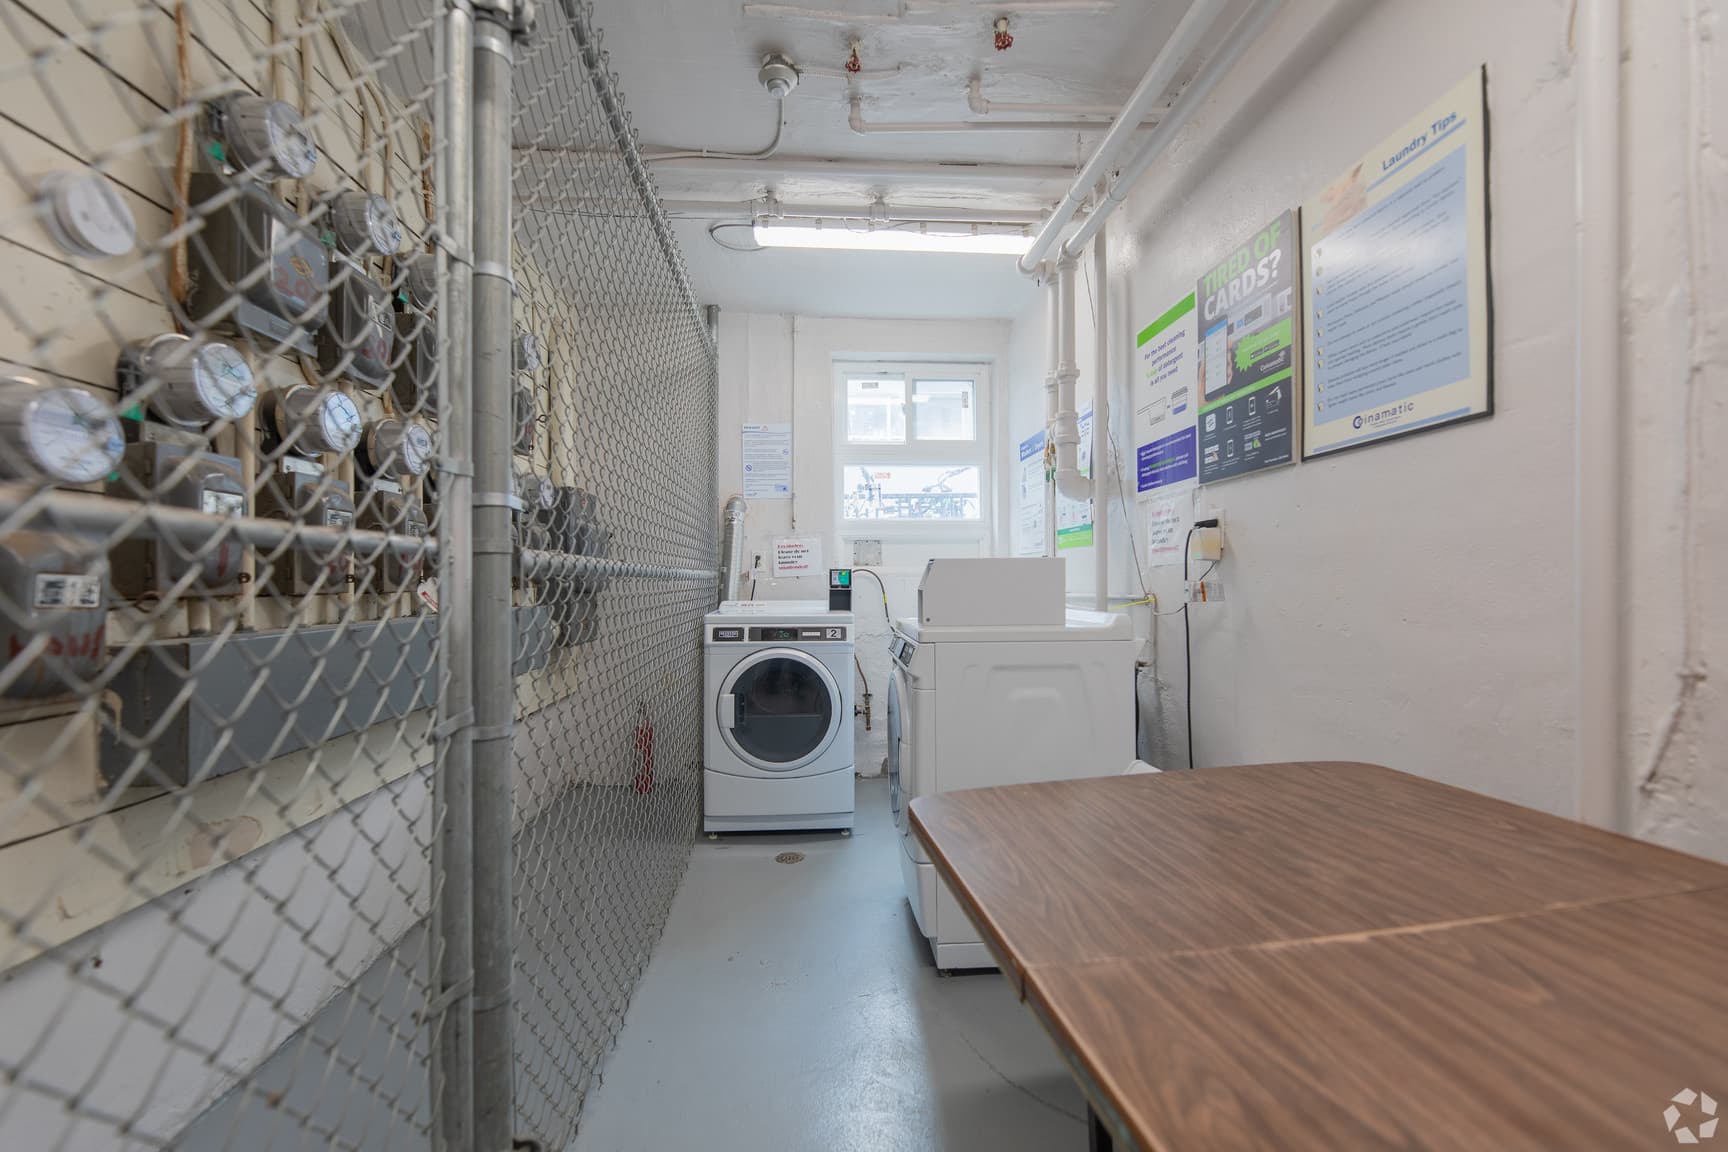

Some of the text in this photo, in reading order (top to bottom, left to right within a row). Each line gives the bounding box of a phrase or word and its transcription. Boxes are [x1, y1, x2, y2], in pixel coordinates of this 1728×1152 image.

[1382, 111, 1457, 171] Laundry Tips
[1204, 221, 1281, 297] TIRED OF
[1204, 249, 1281, 321] CARDS?
[830, 629, 837, 638] 2
